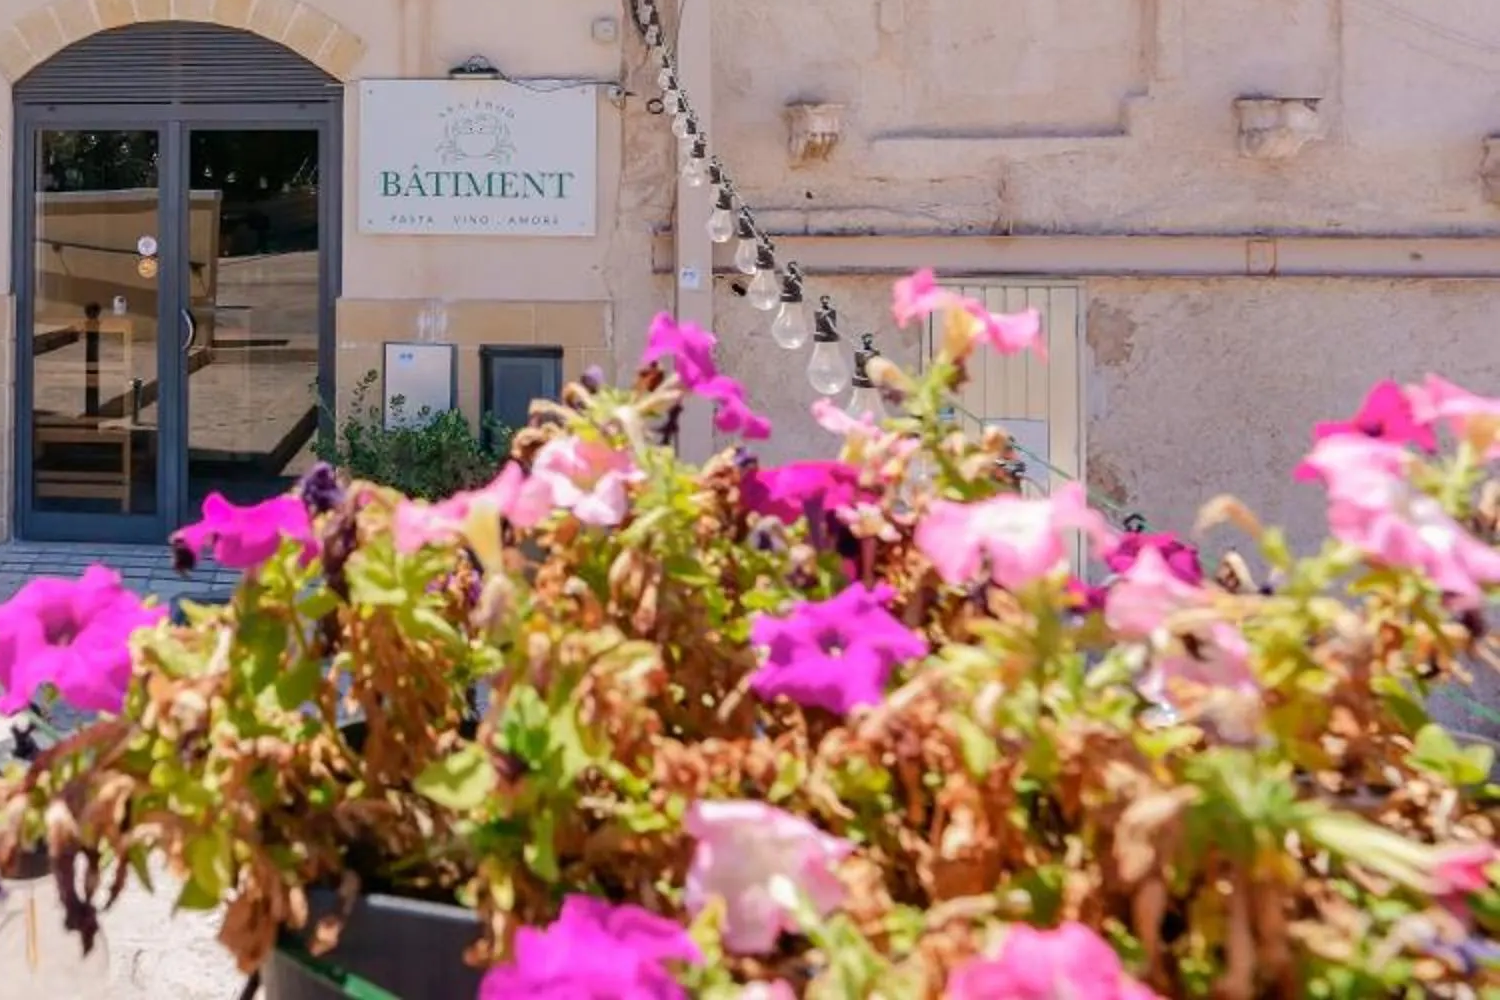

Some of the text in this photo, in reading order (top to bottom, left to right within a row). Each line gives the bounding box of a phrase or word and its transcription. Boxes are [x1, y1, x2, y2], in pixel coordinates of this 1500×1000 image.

[380, 164, 575, 200] BÂTIMENT
[453, 213, 490, 226] VINO
[509, 213, 560, 226] AMORE
